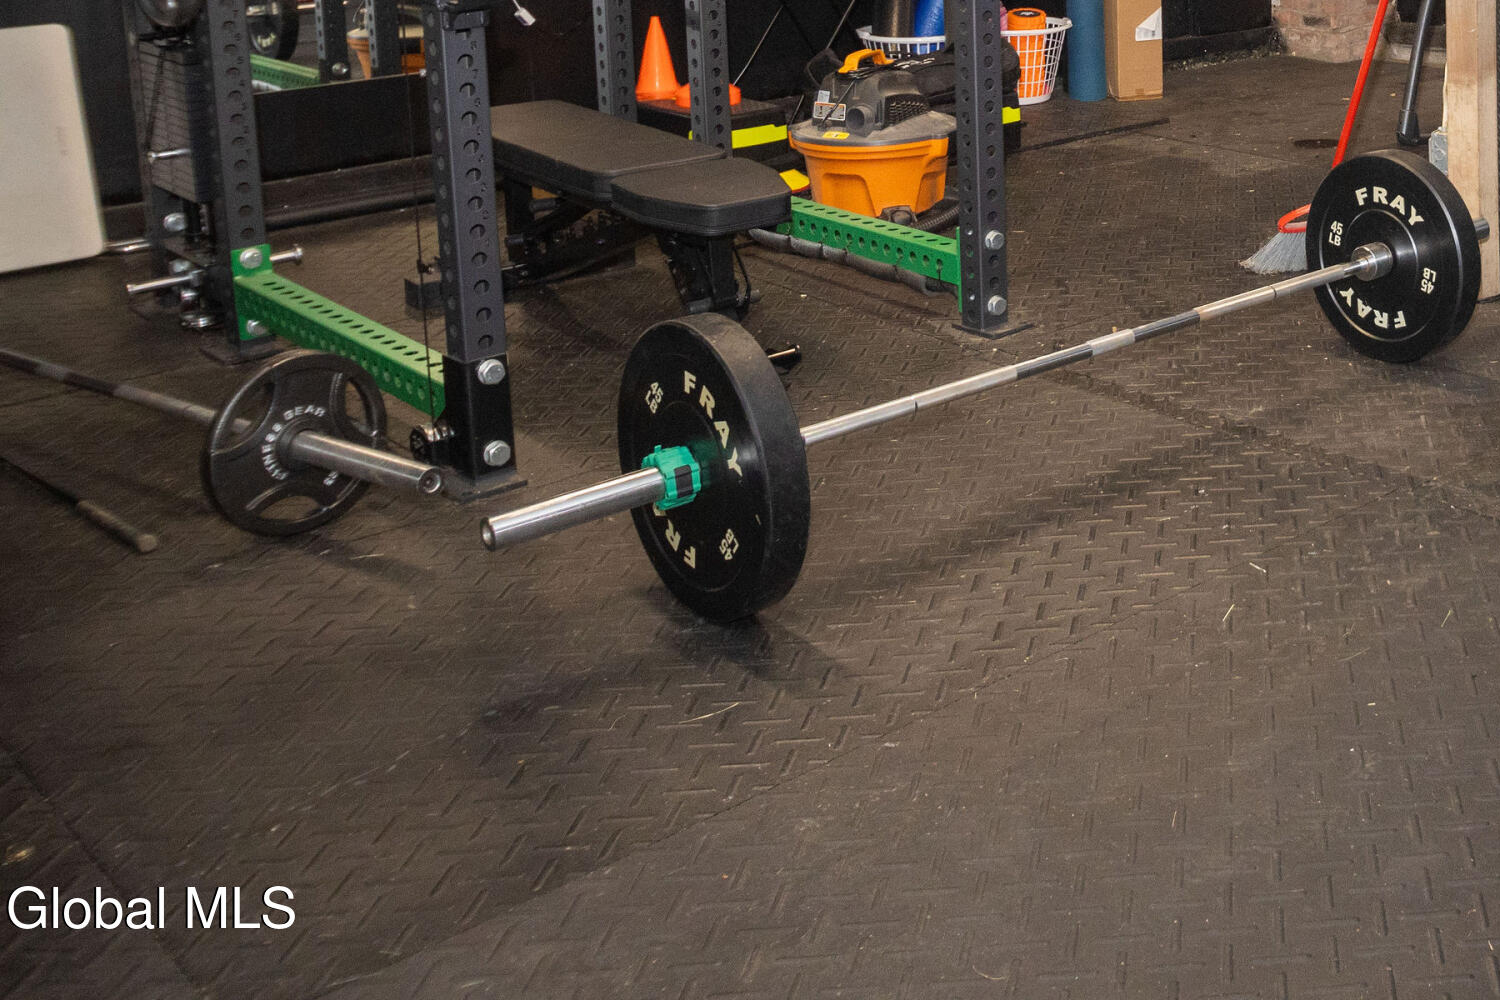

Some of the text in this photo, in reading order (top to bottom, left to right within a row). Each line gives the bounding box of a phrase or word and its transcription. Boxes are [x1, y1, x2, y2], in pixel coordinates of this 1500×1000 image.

[1355, 186, 1424, 226] FRAY
[1330, 220, 1343, 236] 45
[1328, 234, 1342, 247] LB
[1423, 267, 1437, 282] LB
[1420, 279, 1435, 294] 45
[1339, 287, 1407, 329] FRAY
[283, 404, 326, 421] GEAR
[684, 370, 743, 477] FRAY
